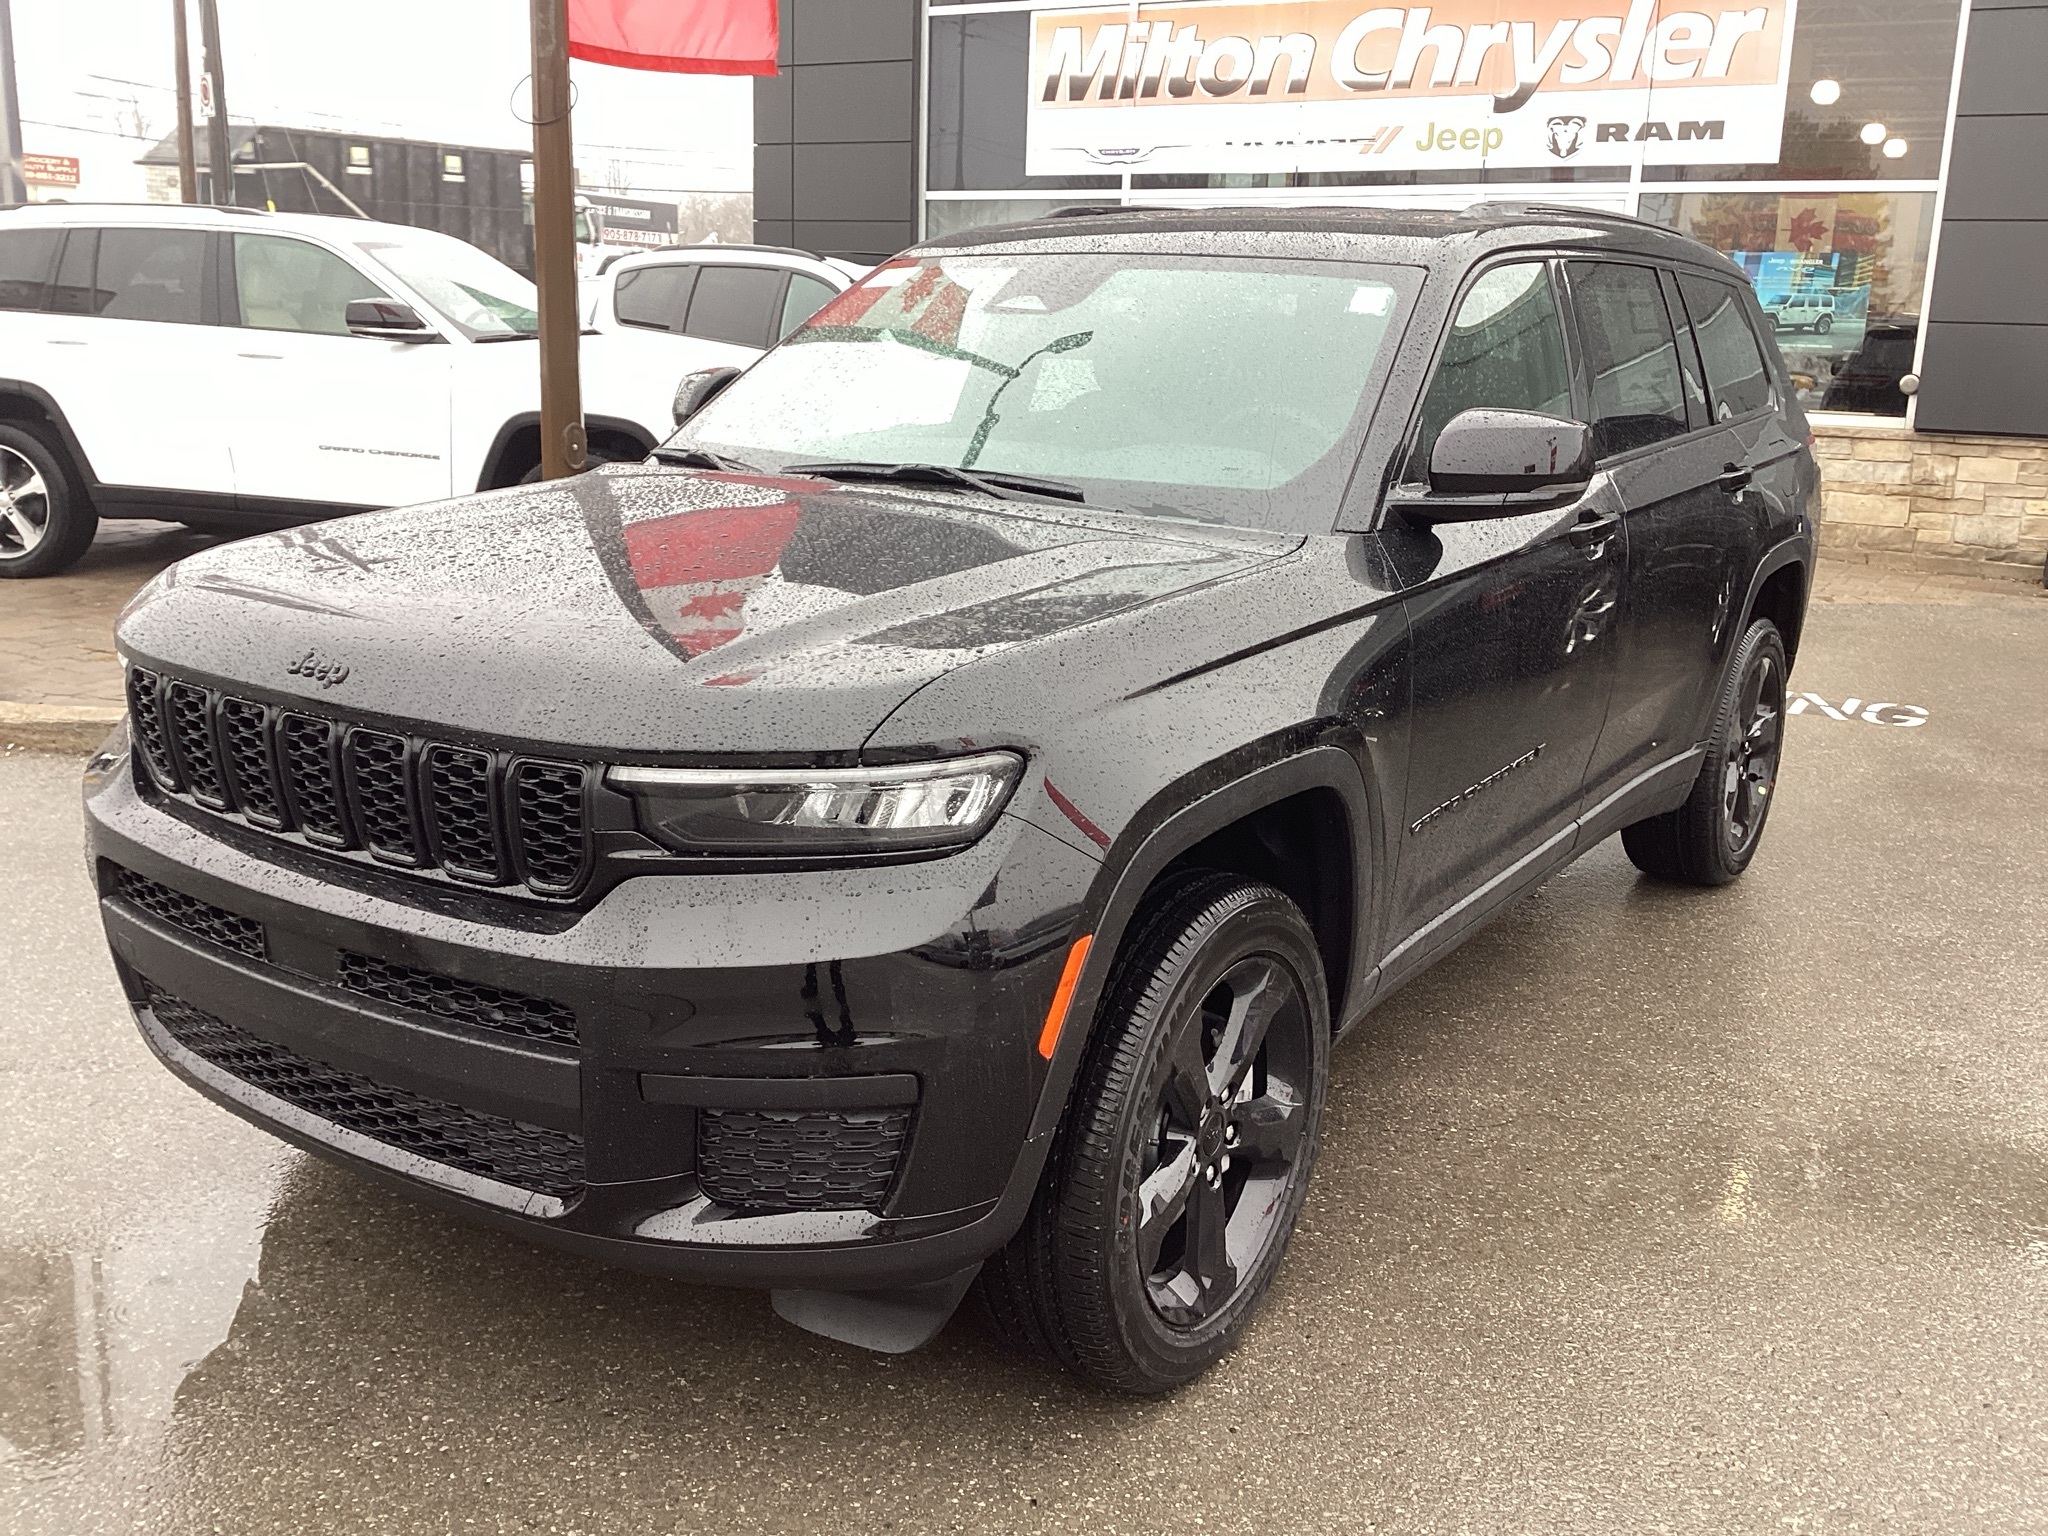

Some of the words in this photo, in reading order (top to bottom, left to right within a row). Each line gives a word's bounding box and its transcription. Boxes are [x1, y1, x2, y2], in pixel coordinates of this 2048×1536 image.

[1041, 20, 1317, 102] Milton
[1329, 0, 1769, 113] Chrysler
[1415, 121, 1504, 158] Jeep
[1595, 119, 1725, 143] RAM
[603, 229, 662, 243] 905-878-7171
[1768, 257, 1786, 265] Jeep
[319, 445, 365, 454] GRAND
[368, 449, 440, 461] CHEROKEE
[286, 651, 350, 690] Jeep
